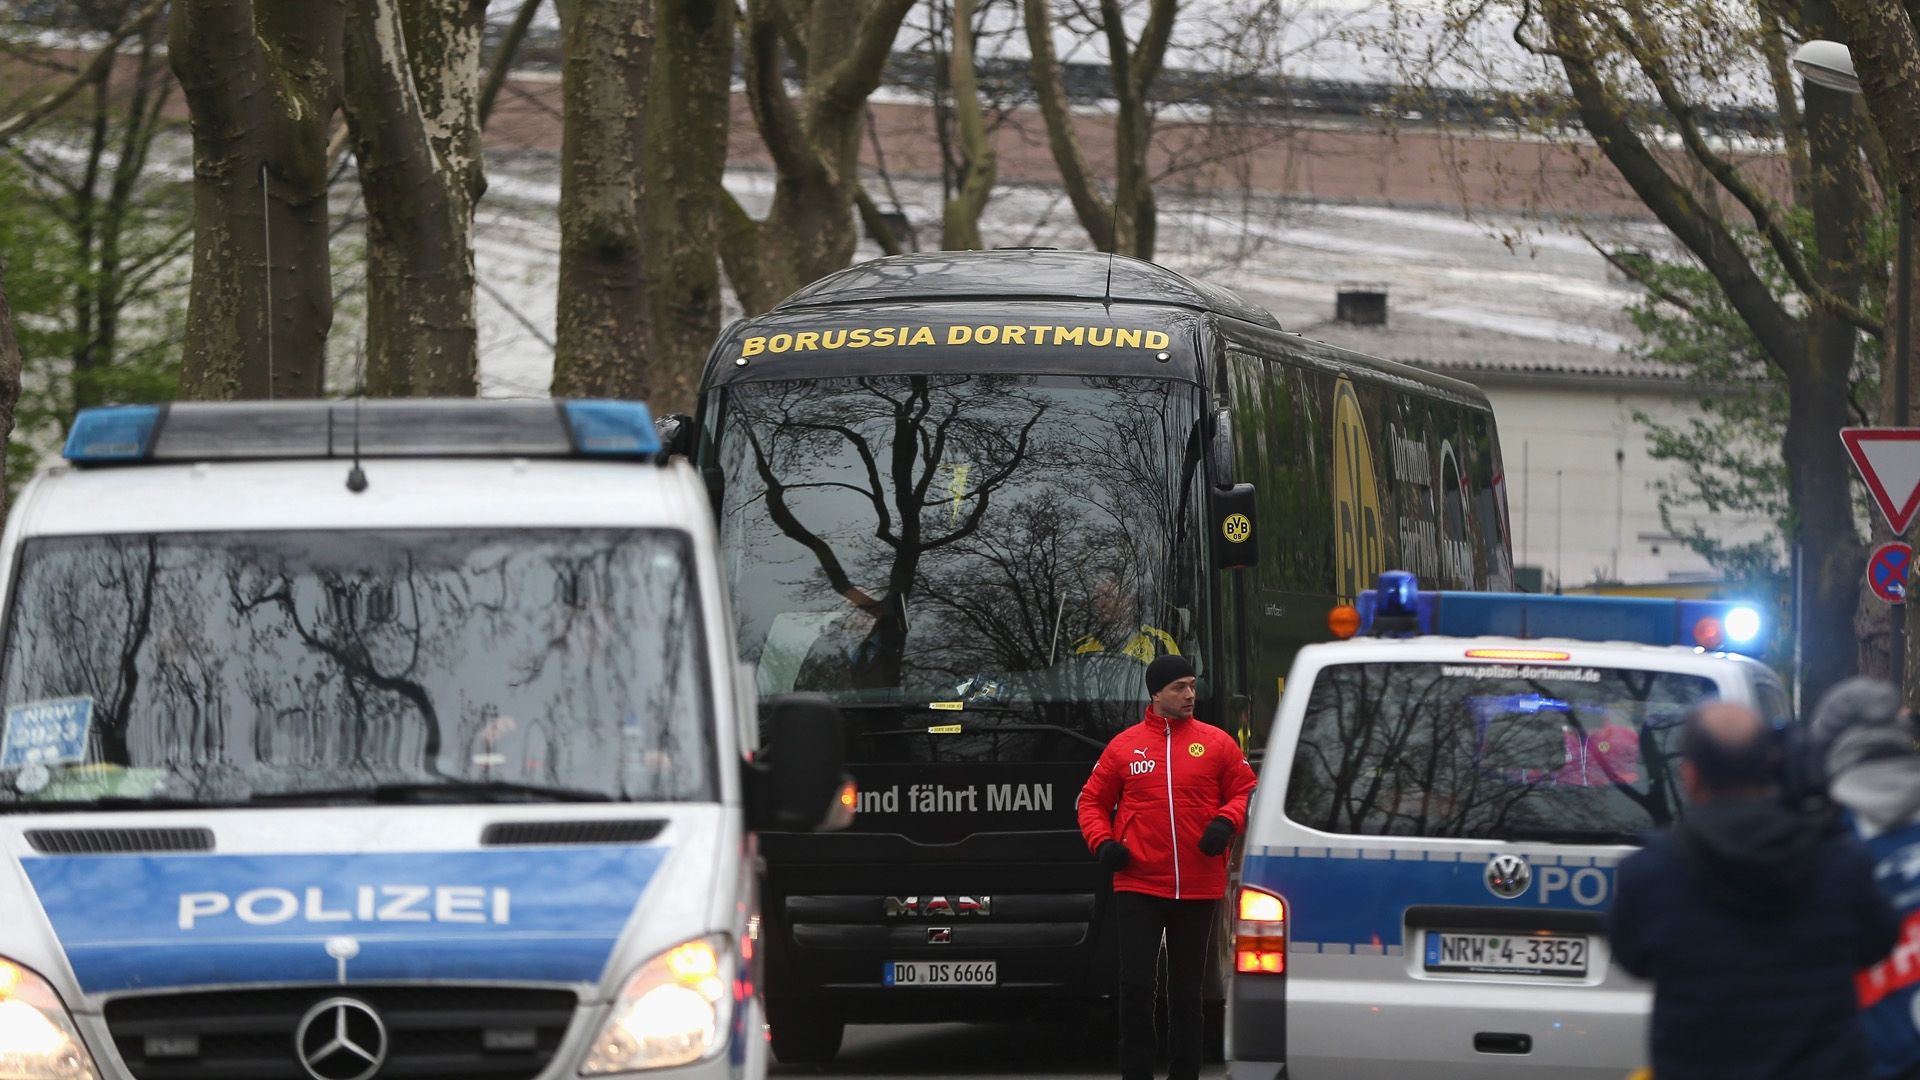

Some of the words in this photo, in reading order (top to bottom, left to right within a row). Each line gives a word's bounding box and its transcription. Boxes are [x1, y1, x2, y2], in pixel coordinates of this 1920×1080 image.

[742, 326, 936, 357] BORUSSIA
[947, 325, 1170, 350] DORTMUND
[1227, 517, 1248, 534] BVB
[1442, 665, 1600, 682] www.polizei-dortmund.de
[1190, 744, 1204, 753] BVB
[1129, 760, 1156, 775] 1009
[908, 784, 978, 813] fährt
[987, 783, 1053, 812] MAN
[1539, 866, 1618, 906] PO
[178, 885, 510, 930] POLIZEI
[886, 896, 991, 916] MAN
[1442, 937, 1485, 962] NRW
[1501, 938, 1584, 966] 4-3352
[895, 964, 916, 982] DO
[929, 964, 949, 982] DS
[954, 964, 994, 982] 6666
